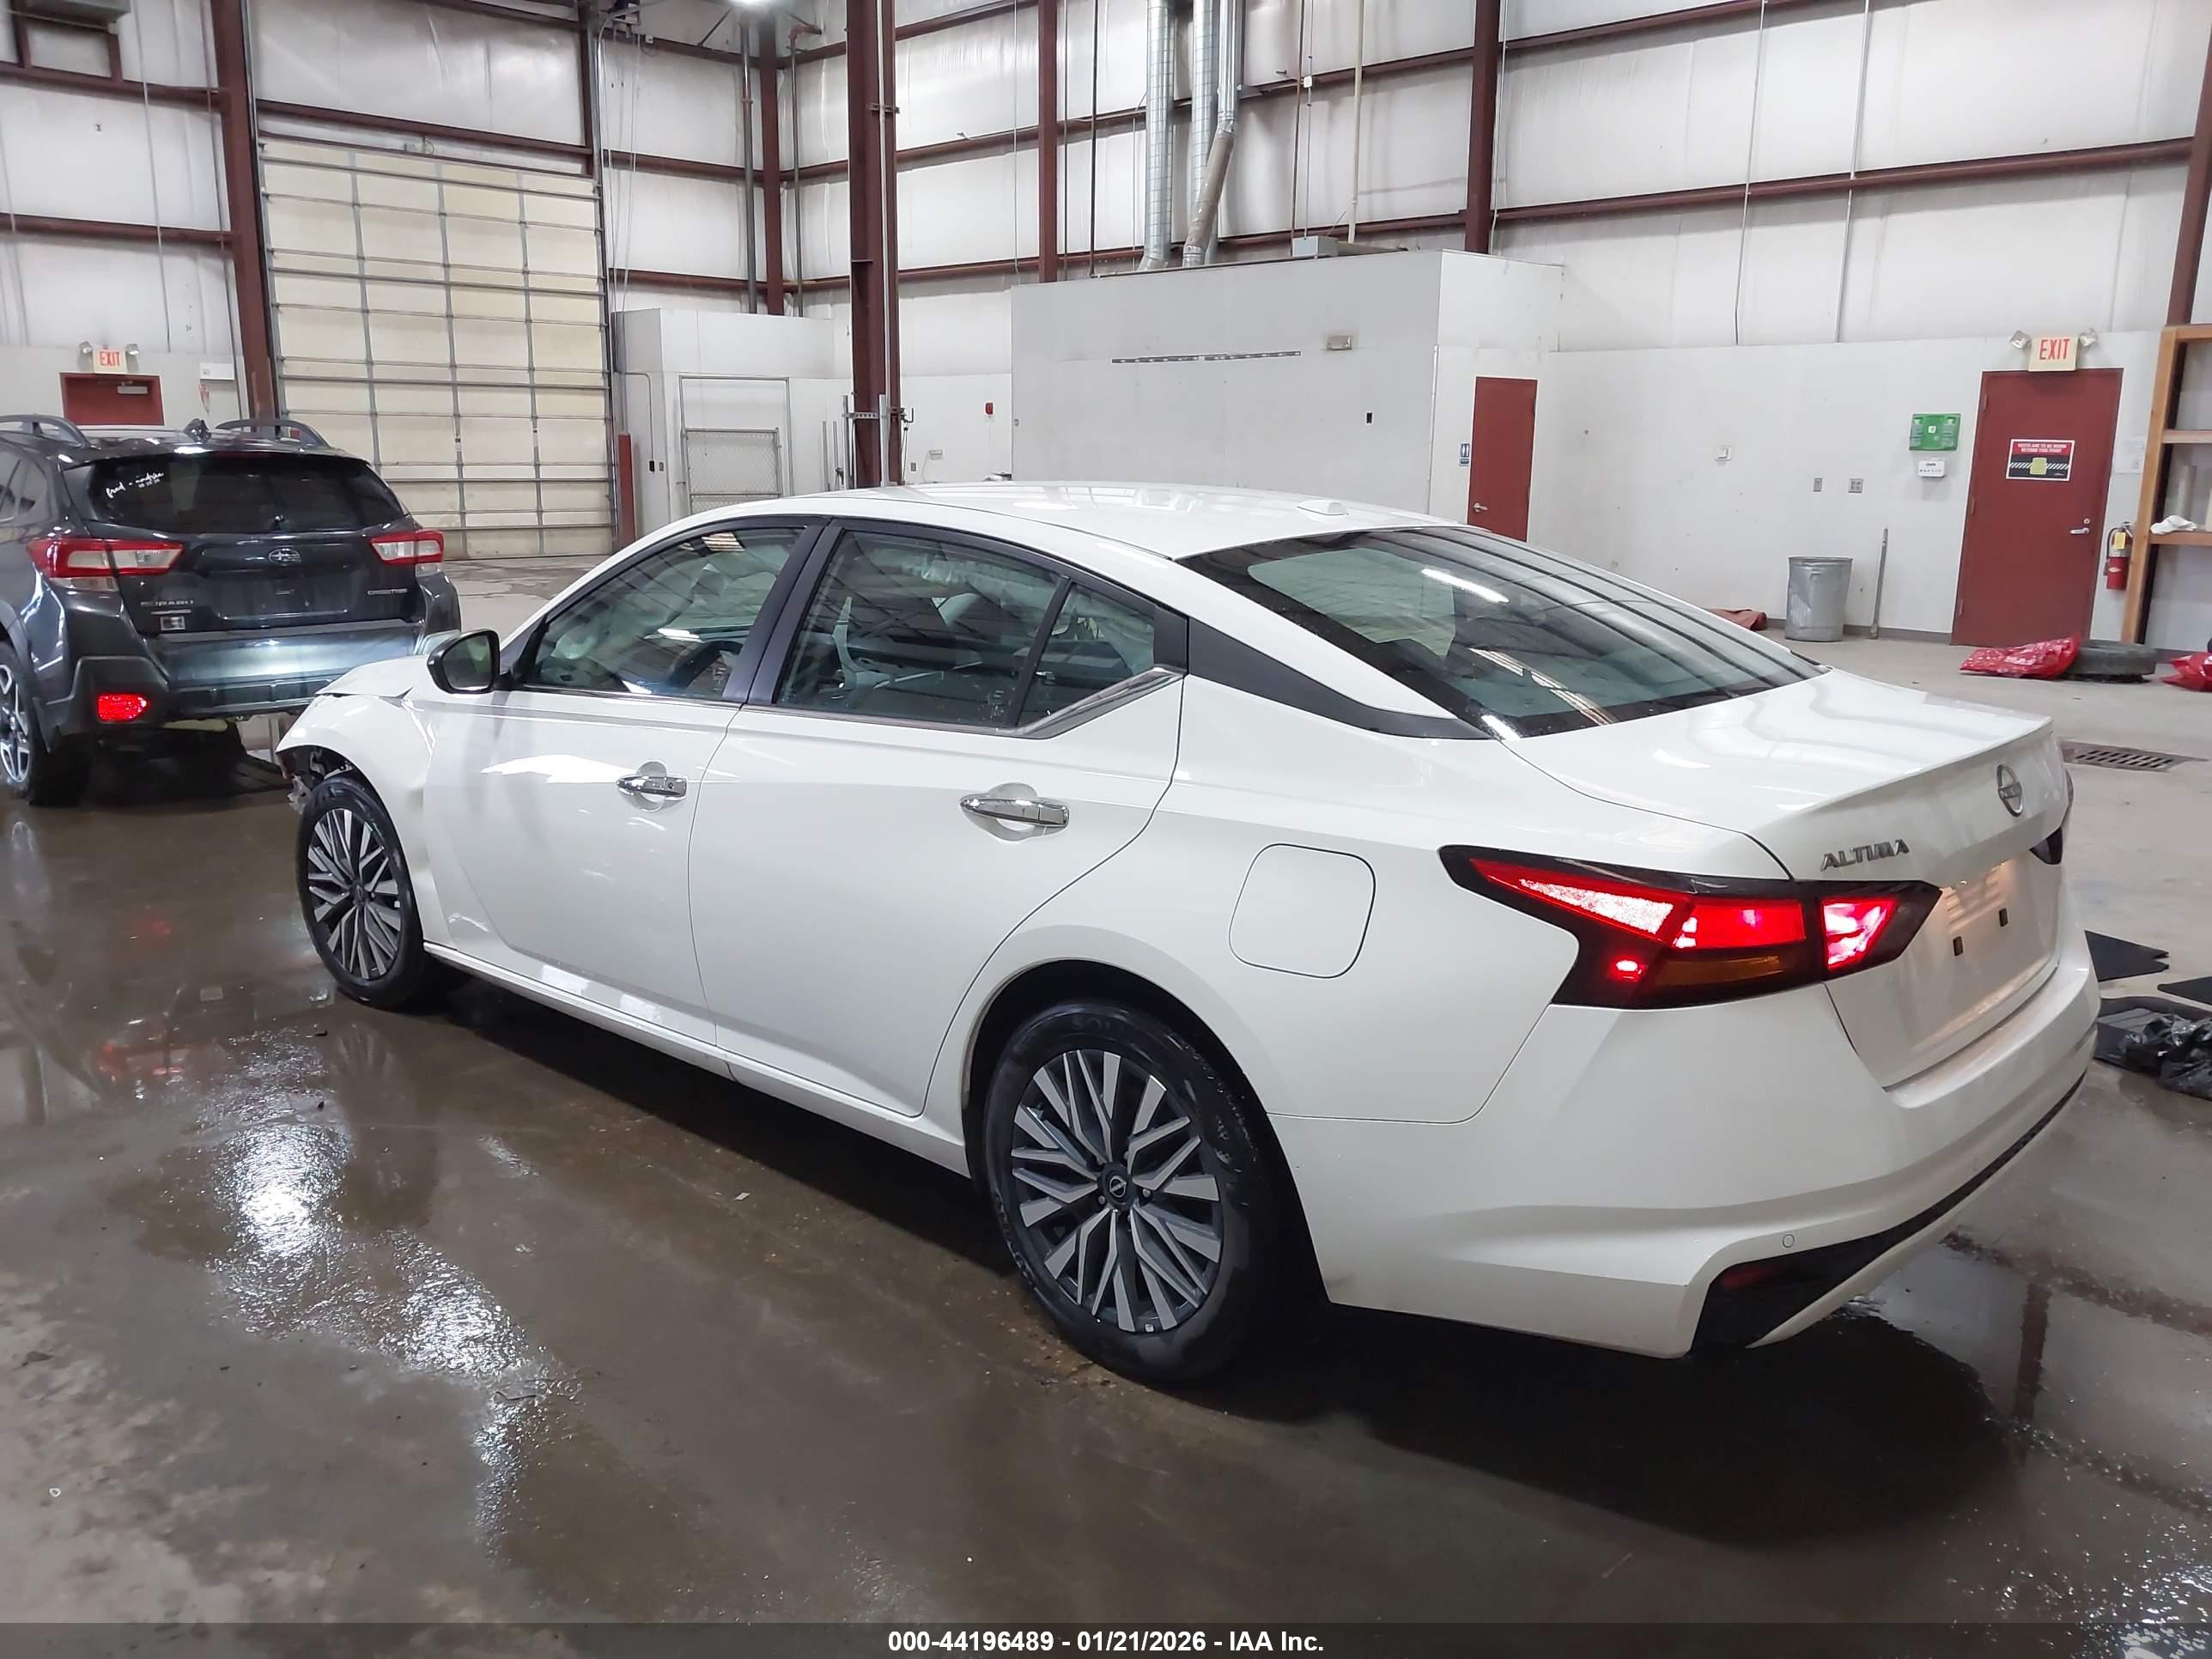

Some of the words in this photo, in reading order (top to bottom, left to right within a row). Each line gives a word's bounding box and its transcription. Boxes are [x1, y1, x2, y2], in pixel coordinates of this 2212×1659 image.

[100, 351, 120, 367] EXIT
[2039, 338, 2070, 360] EXIT
[1820, 839, 1911, 872] ALTIMA
